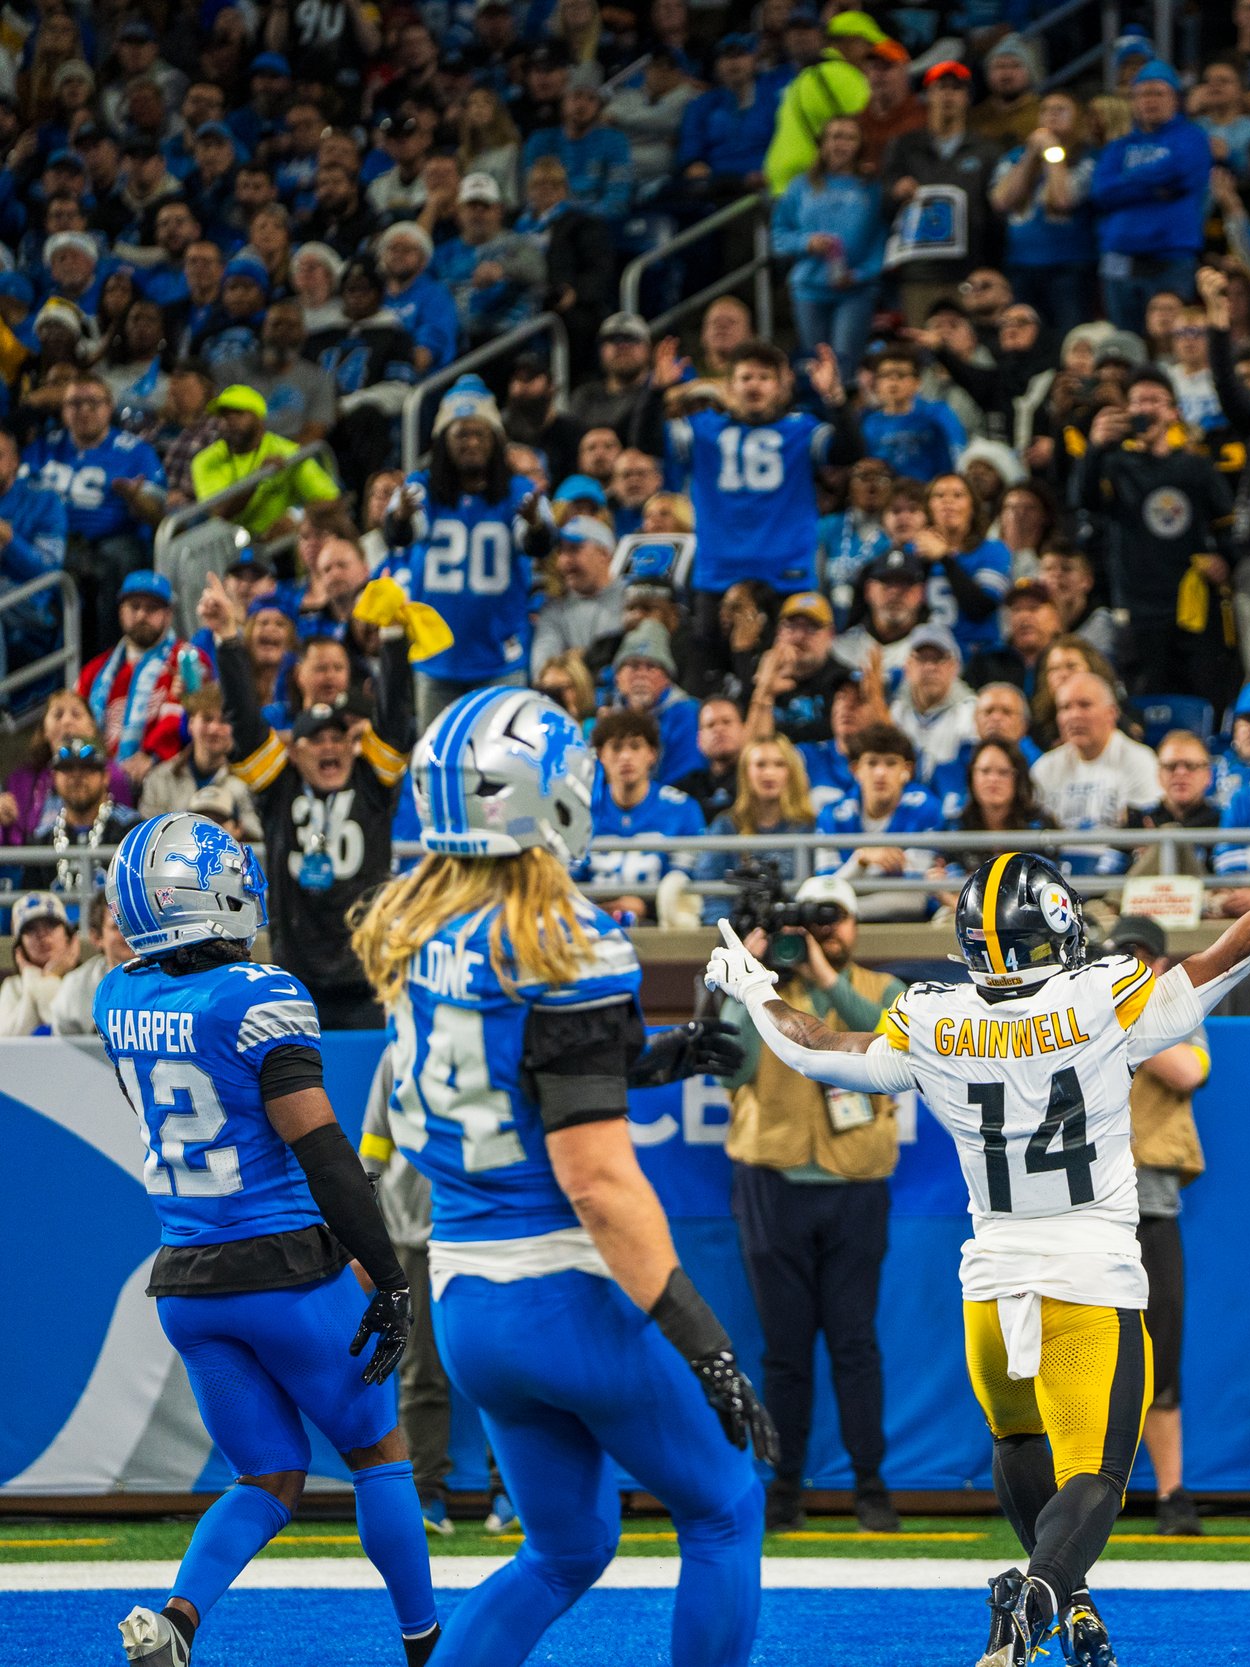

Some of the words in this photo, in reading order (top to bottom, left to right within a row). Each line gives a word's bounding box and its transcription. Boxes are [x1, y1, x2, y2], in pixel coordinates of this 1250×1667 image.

[718, 426, 784, 492] 16
[424, 519, 511, 594] 20
[288, 788, 365, 881] 36
[984, 976, 1024, 987] Steelers
[108, 1009, 196, 1053] HARPER
[934, 1007, 1090, 1059] GAINWELL
[118, 1057, 244, 1198] 12
[967, 1066, 1097, 1212] 14
